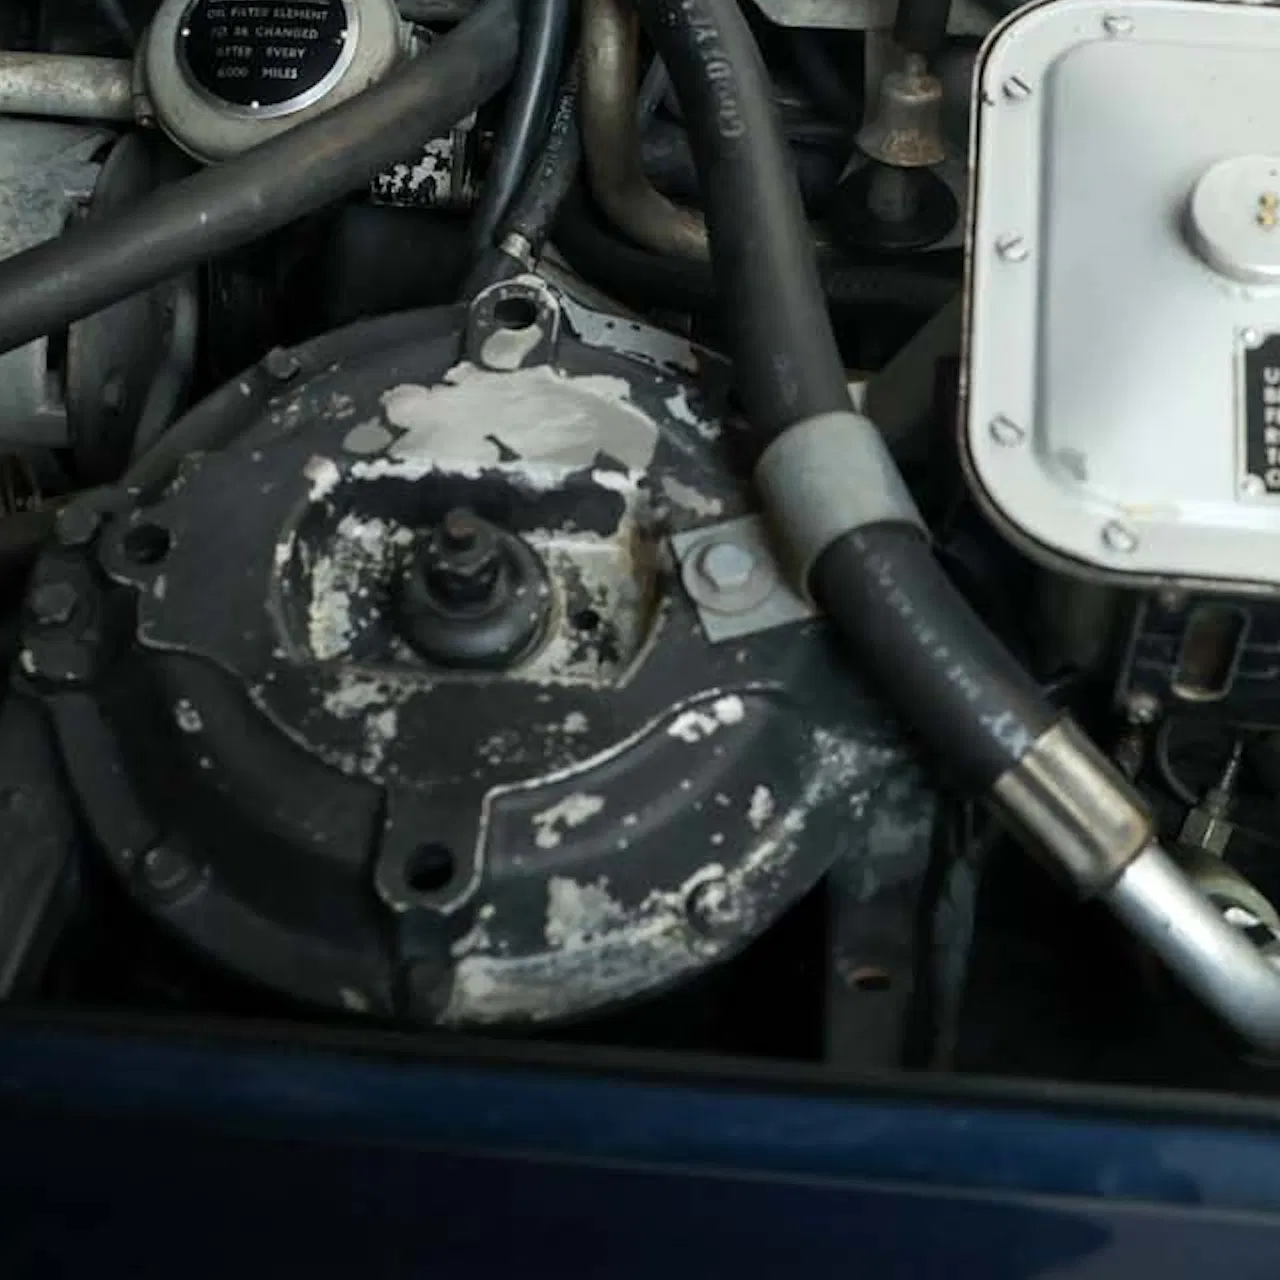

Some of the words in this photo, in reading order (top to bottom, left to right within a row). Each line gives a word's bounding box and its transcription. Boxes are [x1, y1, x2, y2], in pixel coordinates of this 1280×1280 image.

[230, 6, 272, 19] FILTER
[273, 7, 329, 21] ELEMENT
[255, 24, 321, 40] CHANGED
[215, 45, 254, 59] AFTER
[265, 46, 308, 60] EVERY
[261, 66, 298, 80] MILES
